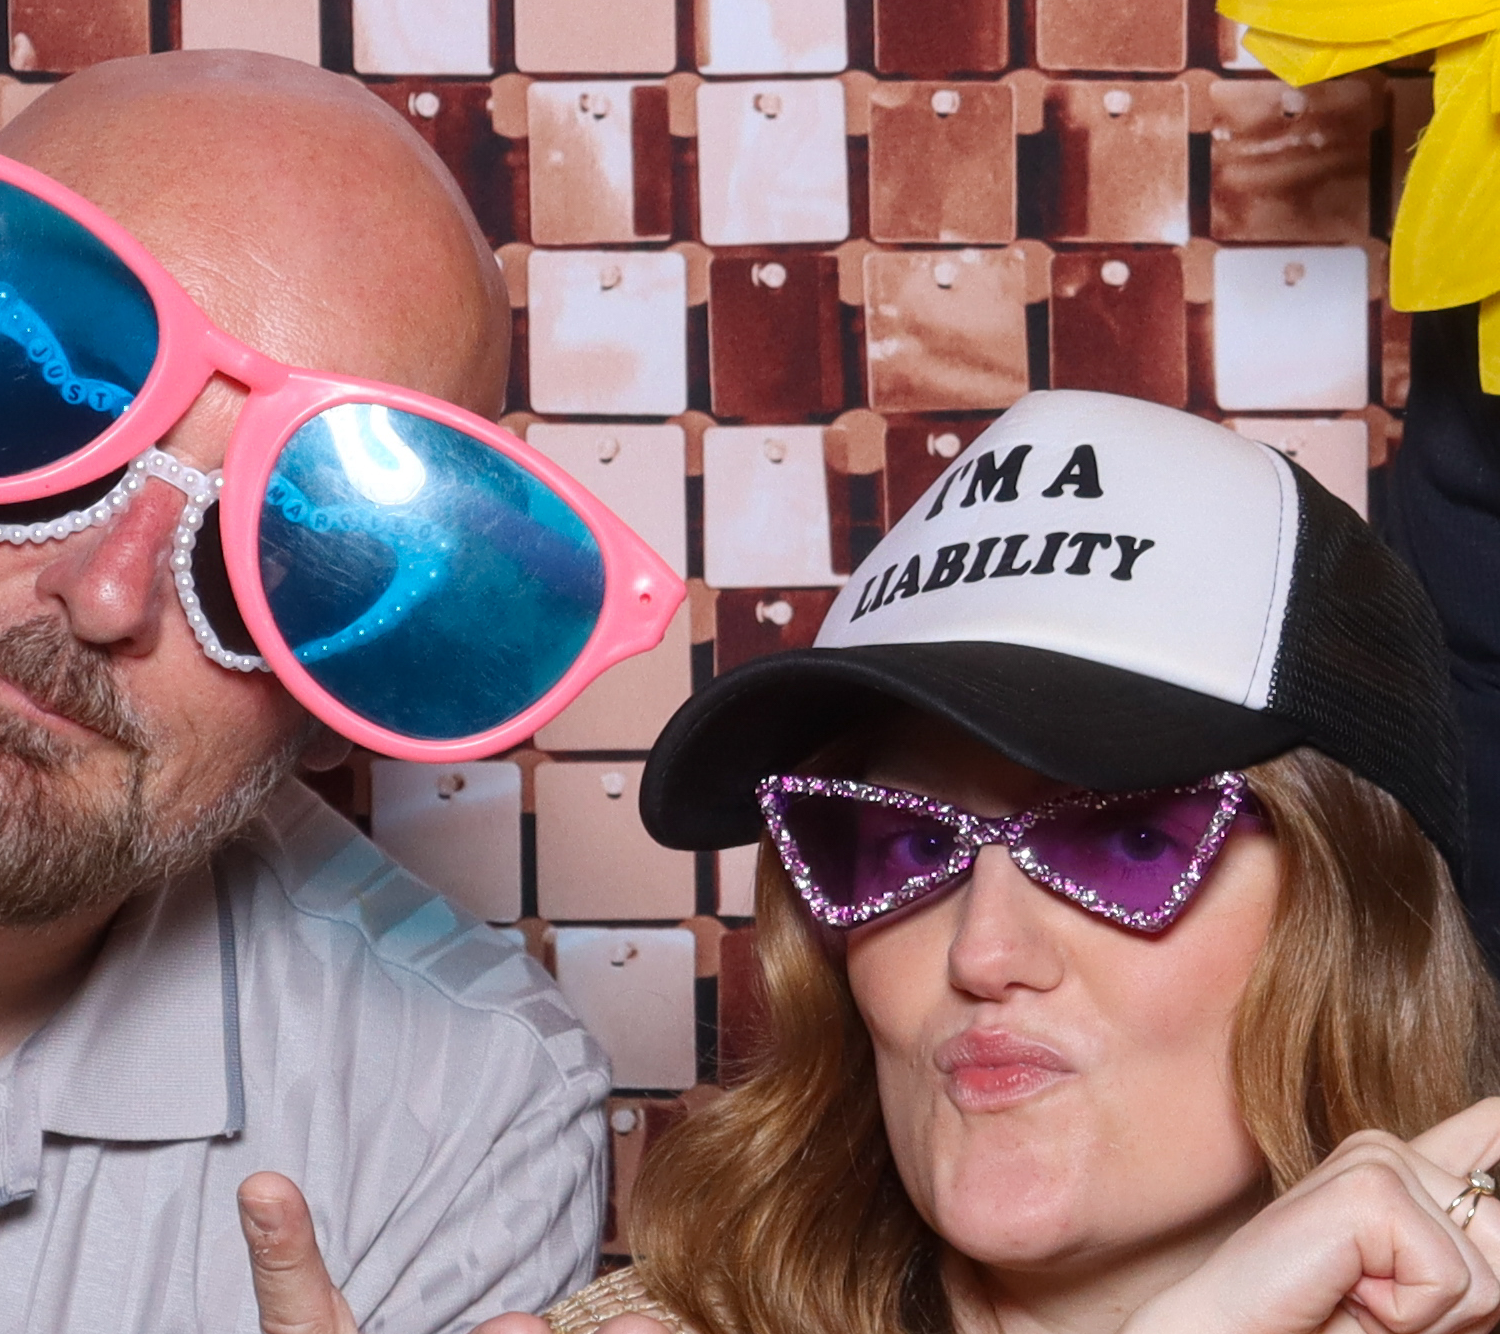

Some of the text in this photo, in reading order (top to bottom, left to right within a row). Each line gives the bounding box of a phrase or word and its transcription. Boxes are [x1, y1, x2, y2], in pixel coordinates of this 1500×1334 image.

[31, 346, 106, 408] JUST
[924, 444, 1104, 521] I'M A
[849, 531, 1155, 623] LIABILITY
